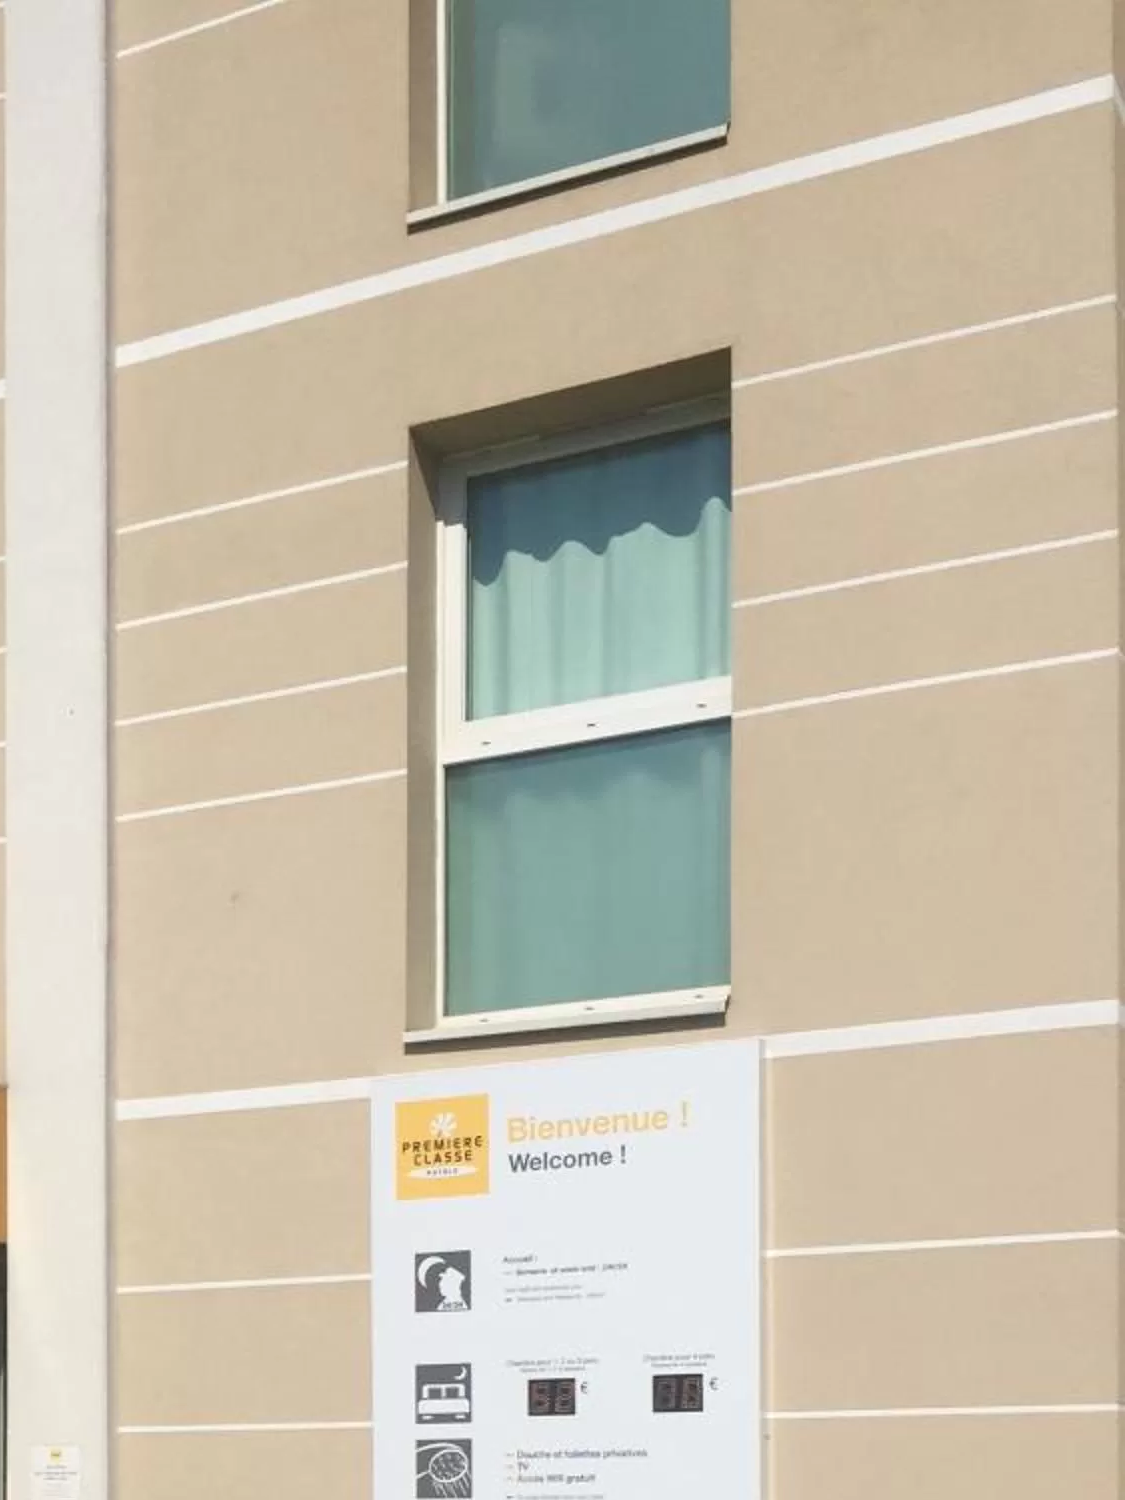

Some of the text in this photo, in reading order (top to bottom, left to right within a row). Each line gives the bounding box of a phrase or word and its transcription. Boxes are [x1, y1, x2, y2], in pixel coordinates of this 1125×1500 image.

[506, 1101, 688, 1144] Bienvenue !
[402, 1135, 484, 1153] PREMIERE
[413, 1149, 473, 1167] CLASSE
[508, 1144, 626, 1173] Welcome !
